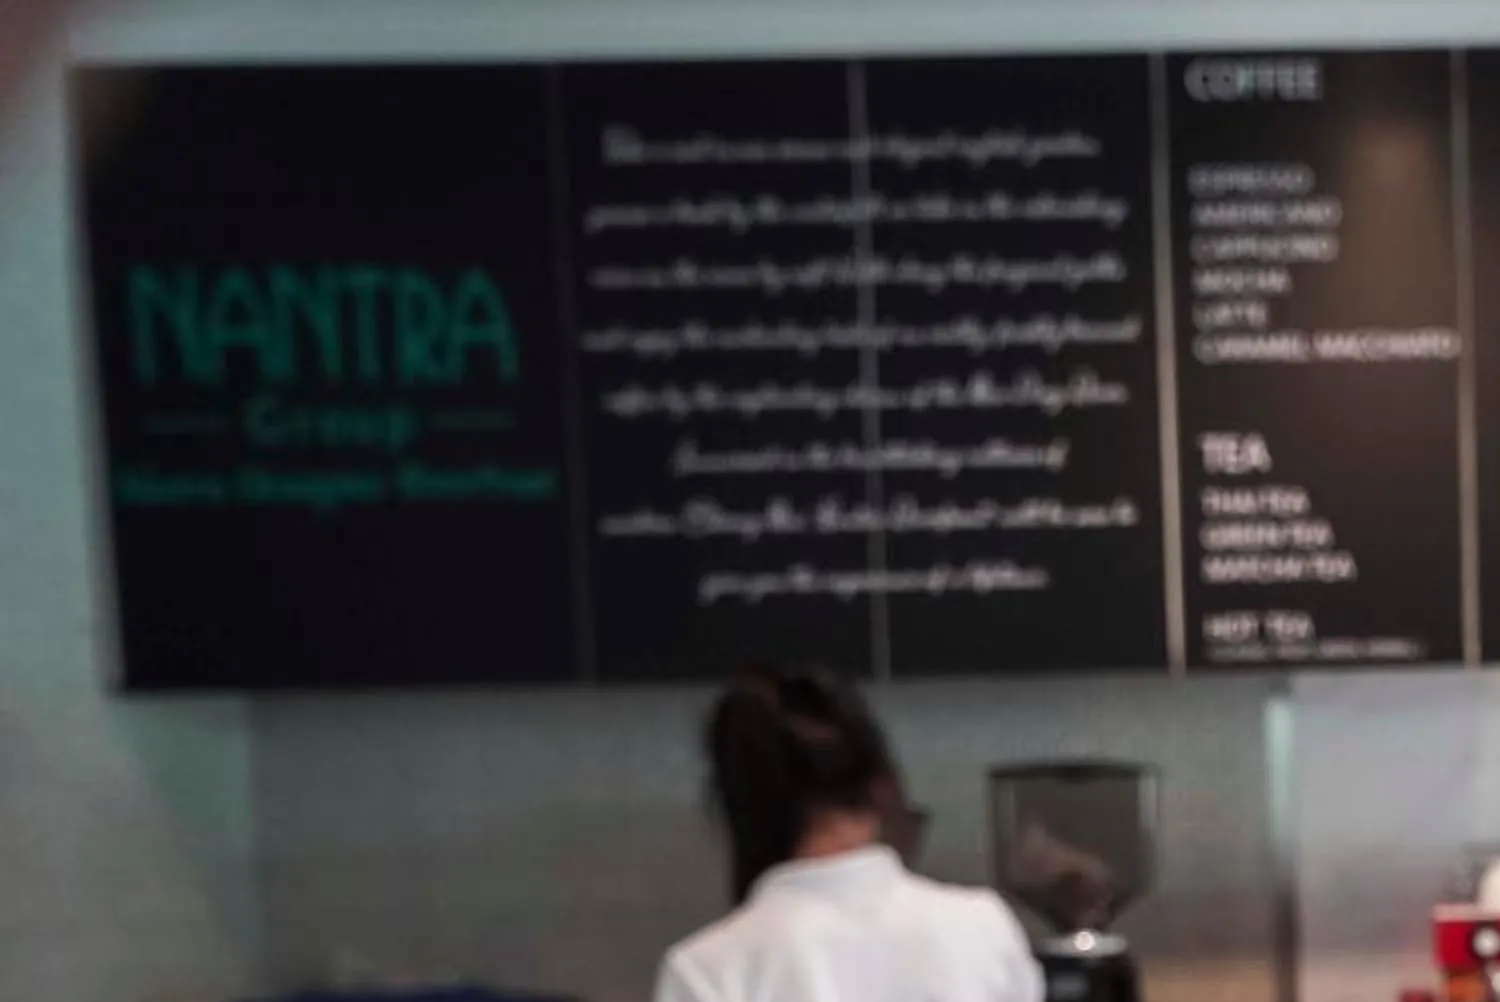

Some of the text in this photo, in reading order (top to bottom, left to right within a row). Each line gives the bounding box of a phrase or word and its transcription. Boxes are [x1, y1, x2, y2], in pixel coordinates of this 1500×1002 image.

[1185, 58, 1323, 101] COFFEE
[1192, 267, 1291, 295] MOCHA
[127, 262, 520, 387] NANTRA
[1193, 301, 1268, 329] LATTE
[1192, 332, 1309, 363] CARAMEL
[1198, 431, 1273, 474] TEA
[1262, 485, 1311, 516] TEA
[1287, 518, 1334, 548] TEA
[1310, 551, 1357, 582] TEA
[1203, 609, 1315, 641] HOT TEA
